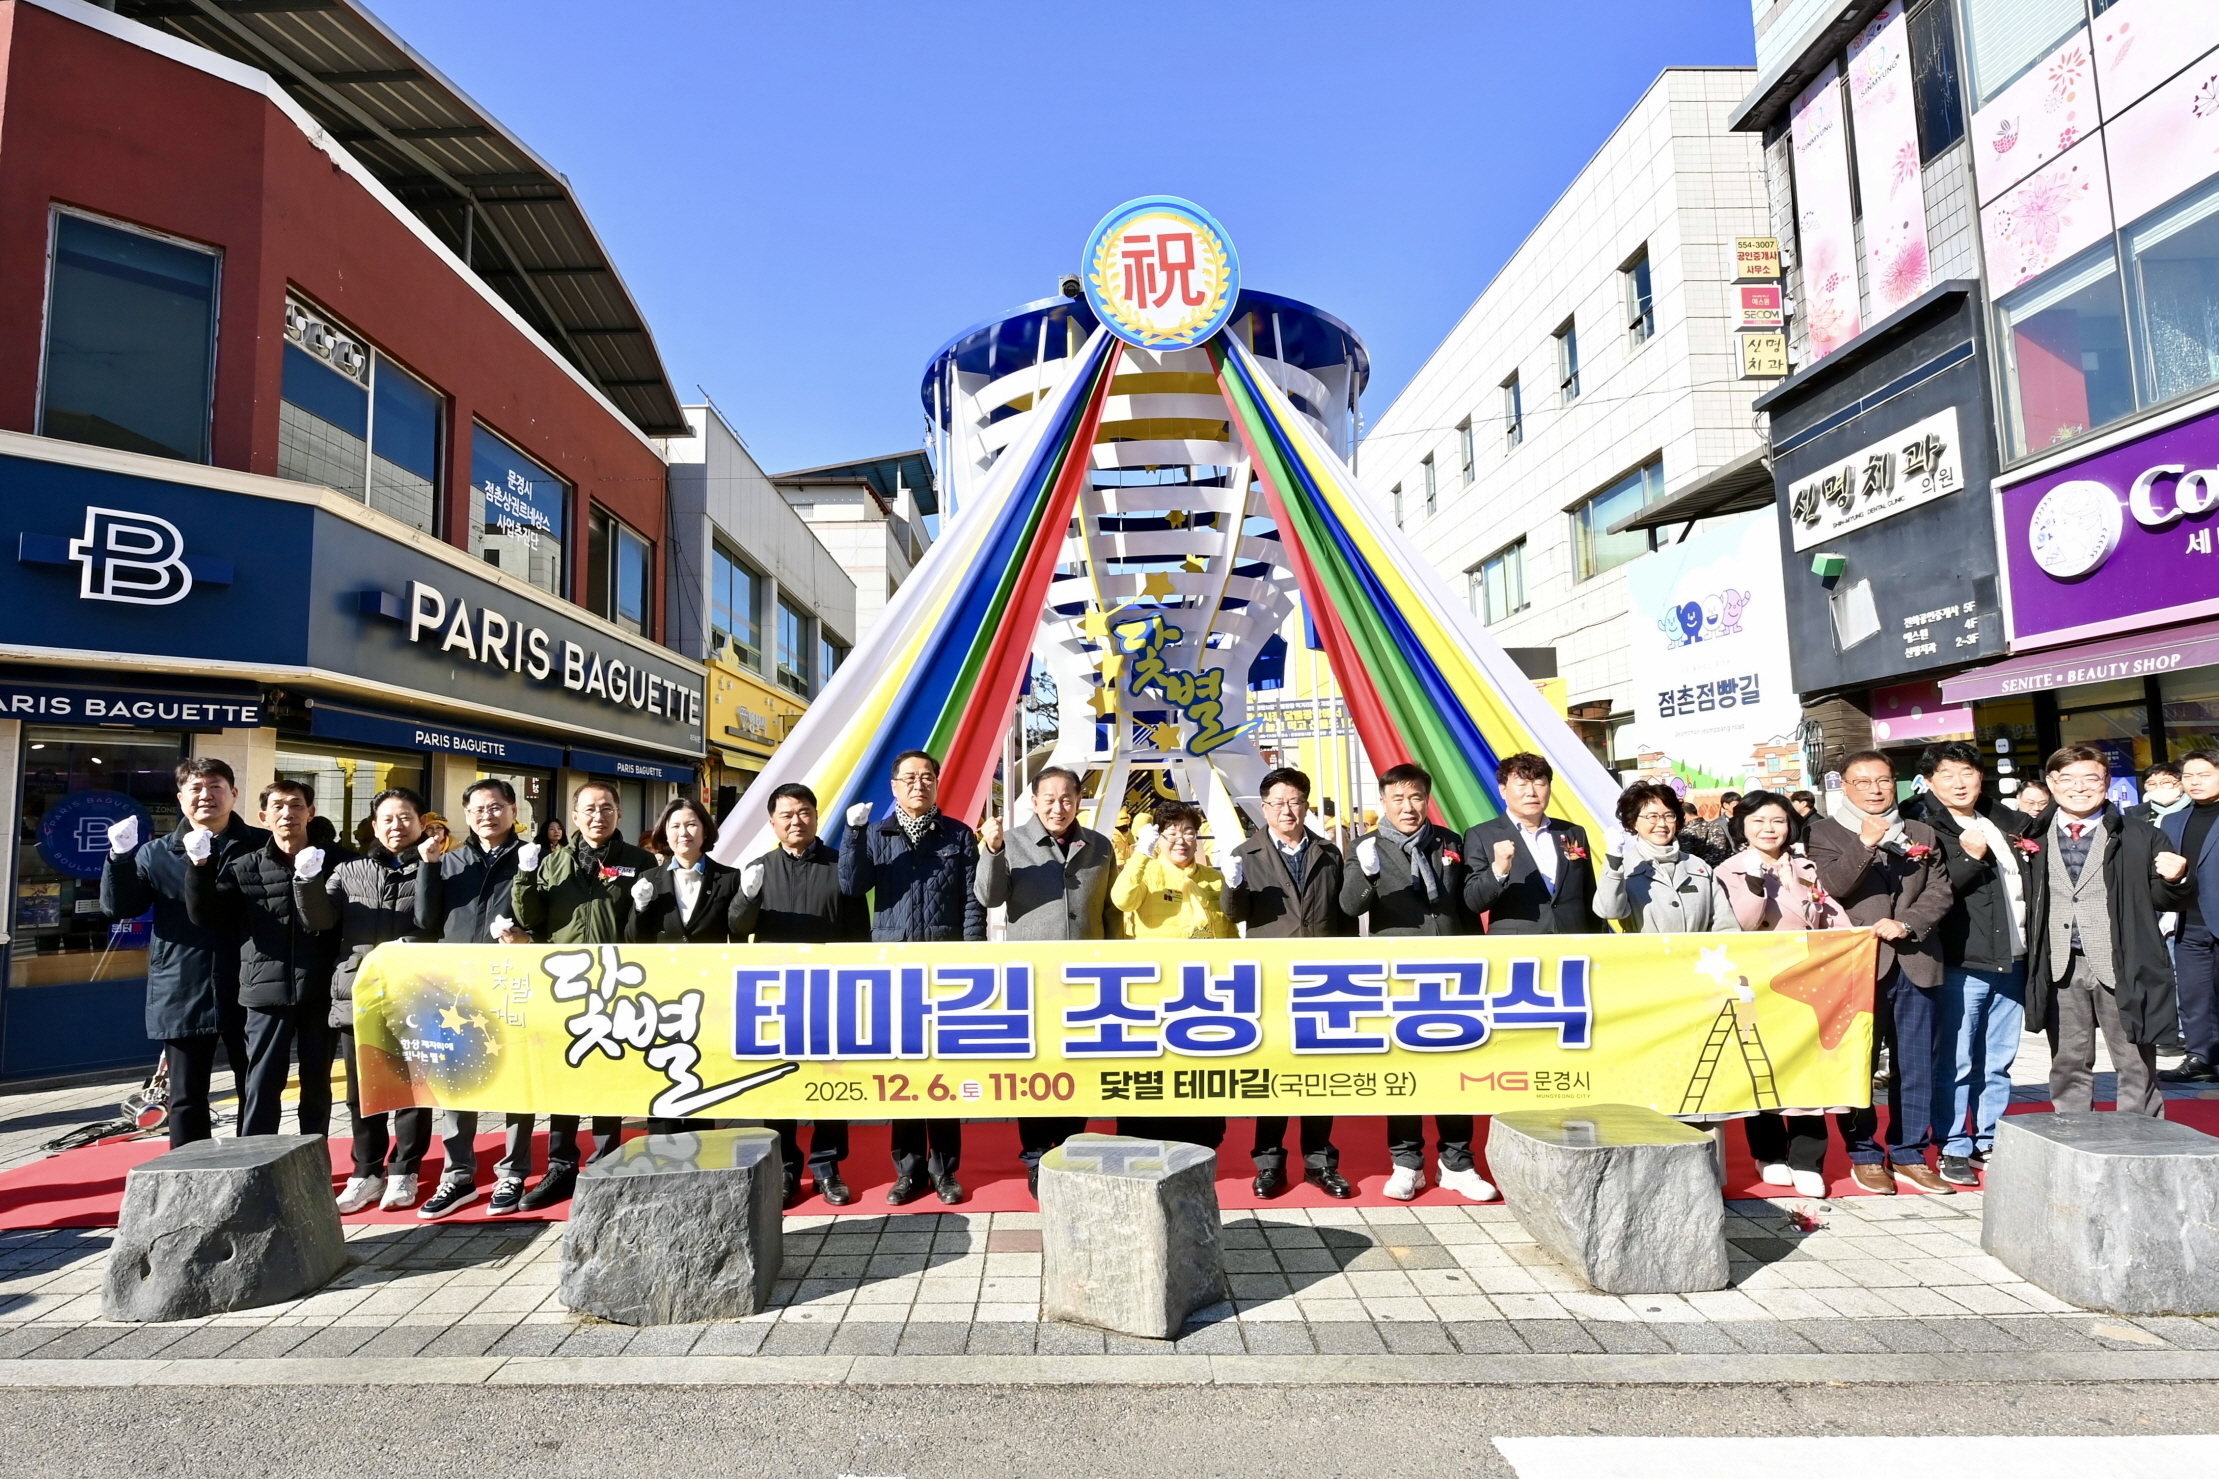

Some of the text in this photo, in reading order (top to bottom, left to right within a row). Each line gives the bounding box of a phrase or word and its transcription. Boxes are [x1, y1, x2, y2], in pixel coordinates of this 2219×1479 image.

[1860, 60, 1897, 98] SINMYUNG
[1737, 241, 1775, 249] 554-3007
[1737, 251, 1777, 261] 공인중개사
[1121, 232, 1206, 309] 祝
[1746, 265, 1771, 275] 사무소
[1744, 310, 1780, 319] SECOM
[1747, 338, 1781, 353] 신명
[1747, 357, 1785, 371] 치과
[507, 469, 533, 501] 문경시
[1922, 466, 1954, 494] 의원
[1867, 503, 1887, 515] DENTAL
[1888, 495, 1906, 508] CLINIC
[2129, 464, 2219, 525] Co
[496, 513, 539, 551] 사업추진단
[2185, 527, 2219, 554] 세
[1963, 601, 1976, 613] 5F
[1964, 617, 1979, 629] 4F
[407, 579, 701, 727] PARIS BAGUETTE
[2001, 653, 2181, 693] SENITE BEAUTY SHOP
[1658, 673, 1761, 718] 점촌점빵길
[85, 699, 259, 723] BAGUETTE
[415, 730, 506, 756] PARIS BAGUETTE
[617, 762, 662, 778] PARIS BAGUETTE
[50, 800, 80, 827] PARIS
[53, 852, 103, 872] BOULAN
[733, 963, 1033, 1058] 테마길
[1062, 961, 1261, 1056] 조성
[1289, 957, 1590, 1052] 준공식
[400, 1038, 455, 1052] 항상 제자리에
[402, 1051, 429, 1062] 빛나는
[804, 1081, 868, 1102] 2025.
[872, 1073, 919, 1102] 12.
[927, 1073, 957, 1102] 6.
[962, 1082, 981, 1098] 토
[989, 1072, 1075, 1101] 11:00
[1100, 1070, 1164, 1101] 닻별
[1460, 1071, 1529, 1092] MG
[1533, 1070, 1591, 1091] 문경시
